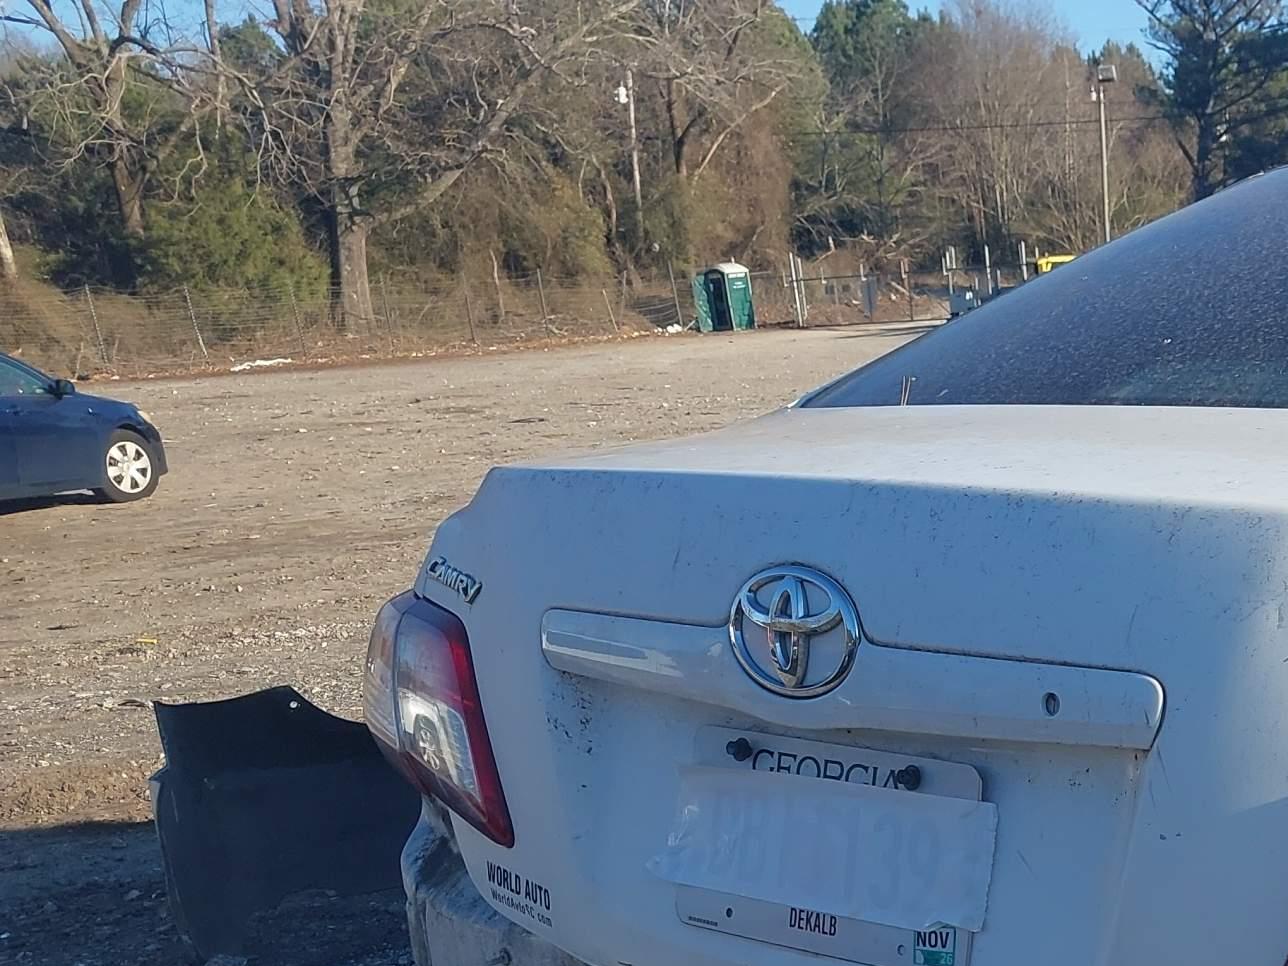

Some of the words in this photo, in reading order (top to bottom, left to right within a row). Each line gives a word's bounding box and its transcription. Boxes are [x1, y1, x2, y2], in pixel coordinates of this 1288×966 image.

[426, 556, 483, 606] CAMRY
[486, 861, 521, 896] WORLD
[524, 879, 551, 911] AUTO
[789, 907, 838, 937] DEKALB
[916, 930, 950, 949] NOV
